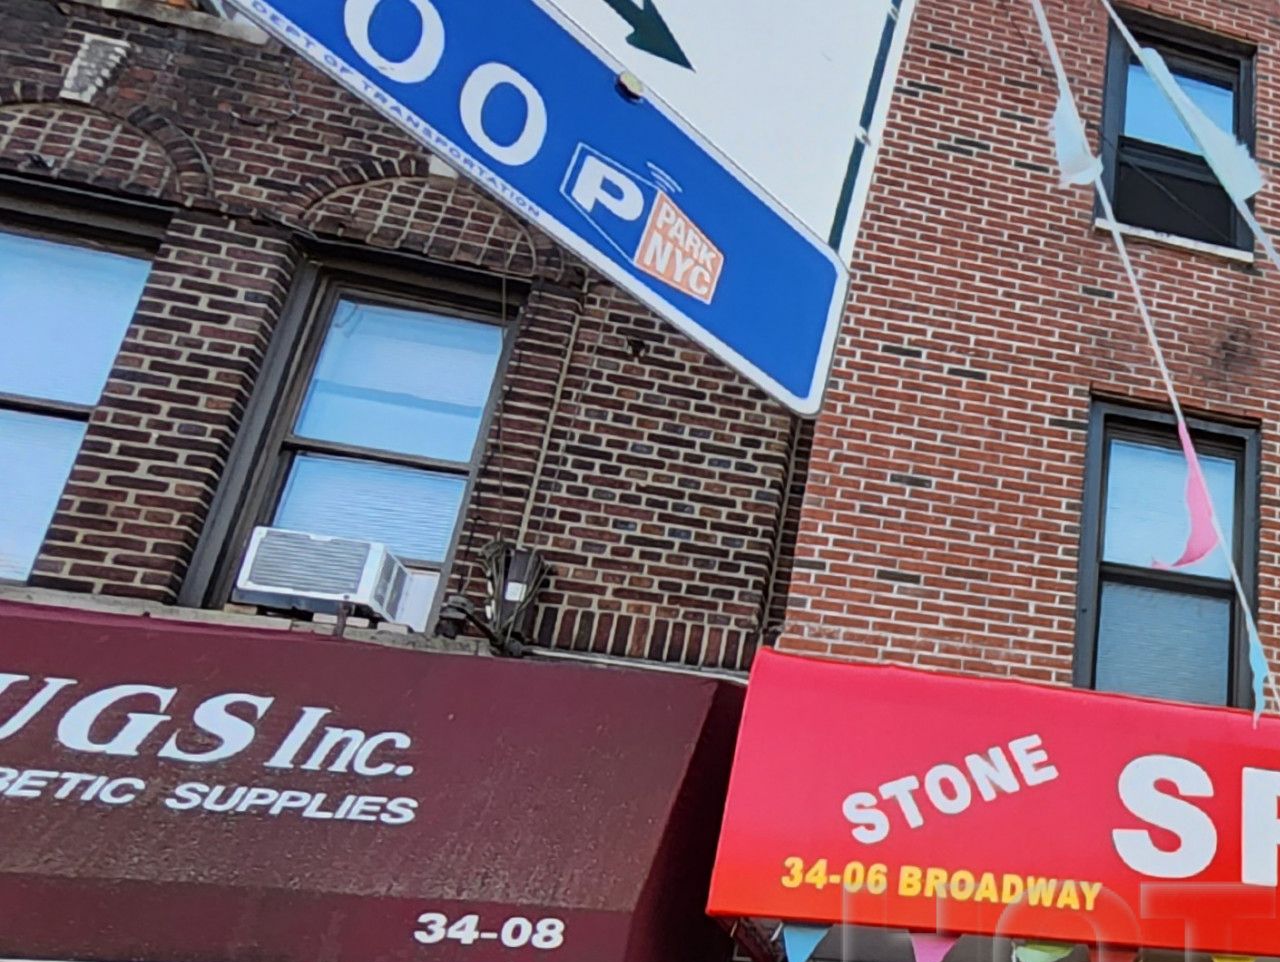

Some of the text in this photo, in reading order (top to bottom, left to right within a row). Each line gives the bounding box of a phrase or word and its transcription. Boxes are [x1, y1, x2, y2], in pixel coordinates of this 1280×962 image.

[324, 53, 354, 76] OF
[362, 80, 542, 219] TRANSPORTATION
[571, 155, 645, 222] P
[643, 231, 712, 296] NYC
[656, 201, 718, 272] PARK
[263, 706, 415, 778] Inc.
[165, 782, 420, 827] SUPPLIES
[842, 733, 1060, 845] STONE
[781, 856, 1103, 912] 34-06 BROADWAY
[413, 911, 565, 950] 34-08
